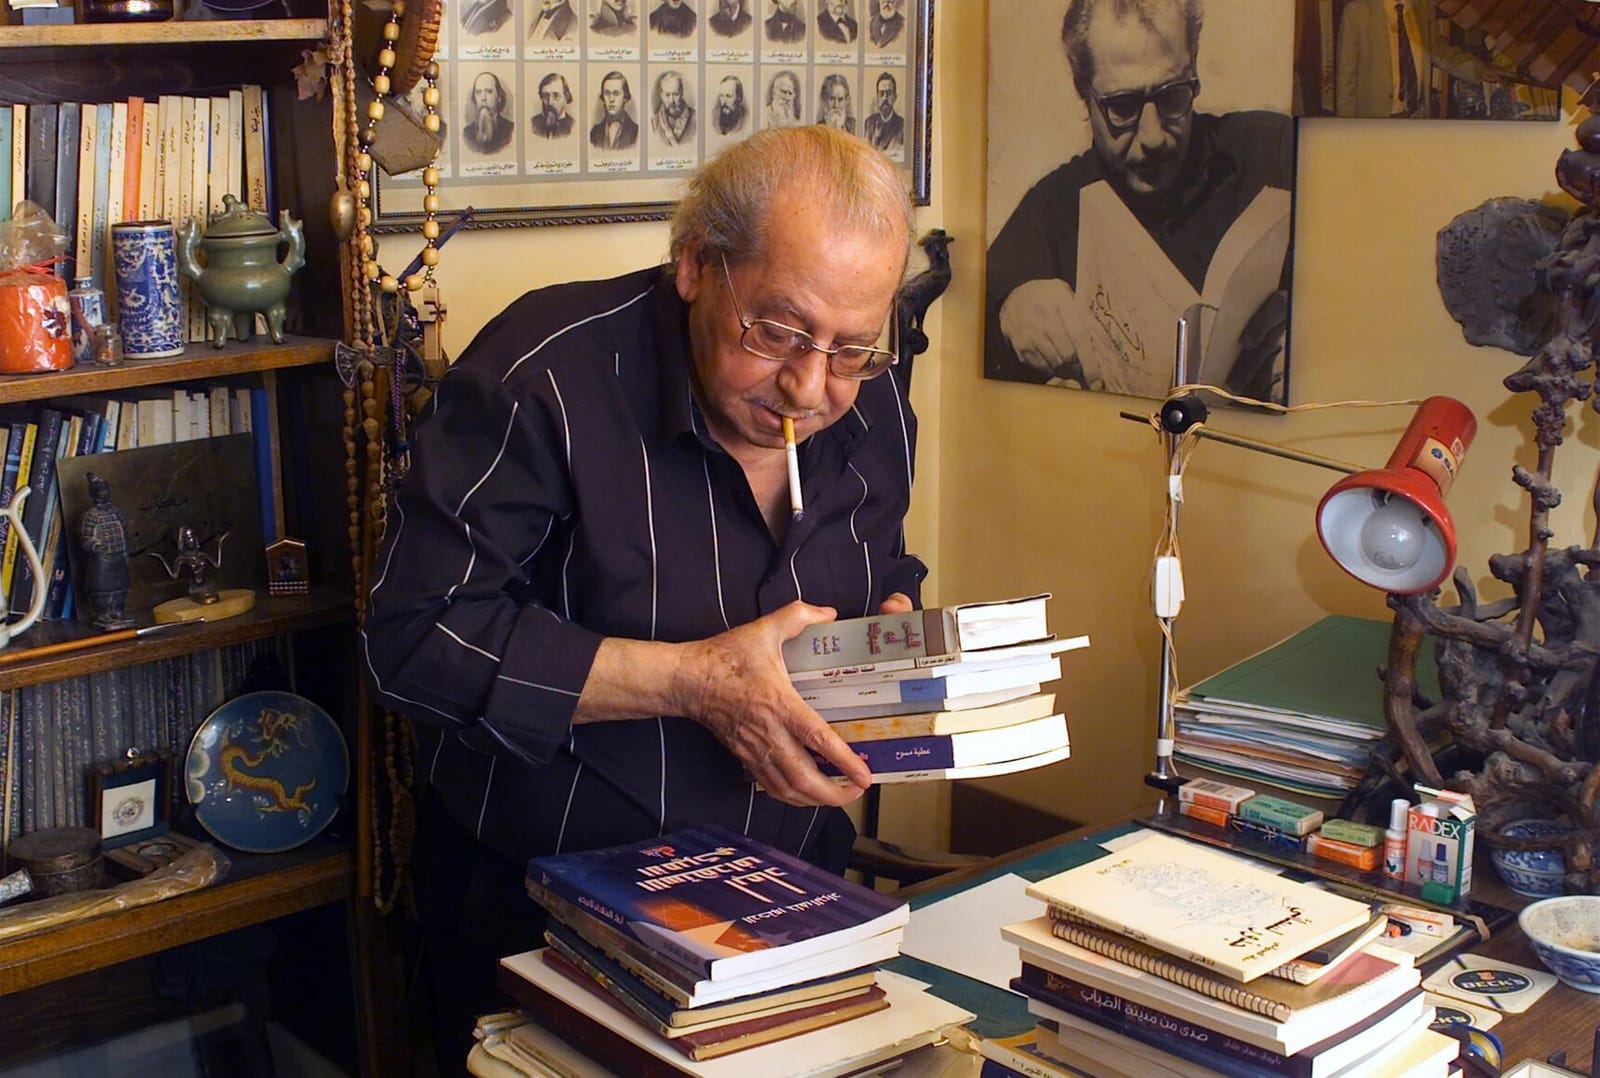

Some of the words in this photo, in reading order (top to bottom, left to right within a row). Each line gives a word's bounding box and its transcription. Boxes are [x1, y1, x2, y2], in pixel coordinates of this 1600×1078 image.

[1409, 814, 1461, 840] RADEX
[636, 855, 763, 892] الاستهداف
[1461, 978, 1526, 989] BECK'S
[1080, 988, 1121, 1012] الضباب
[1124, 1004, 1159, 1027] مدينة
[1159, 1016, 1178, 1032] من
[1179, 1025, 1209, 1042] صدى
